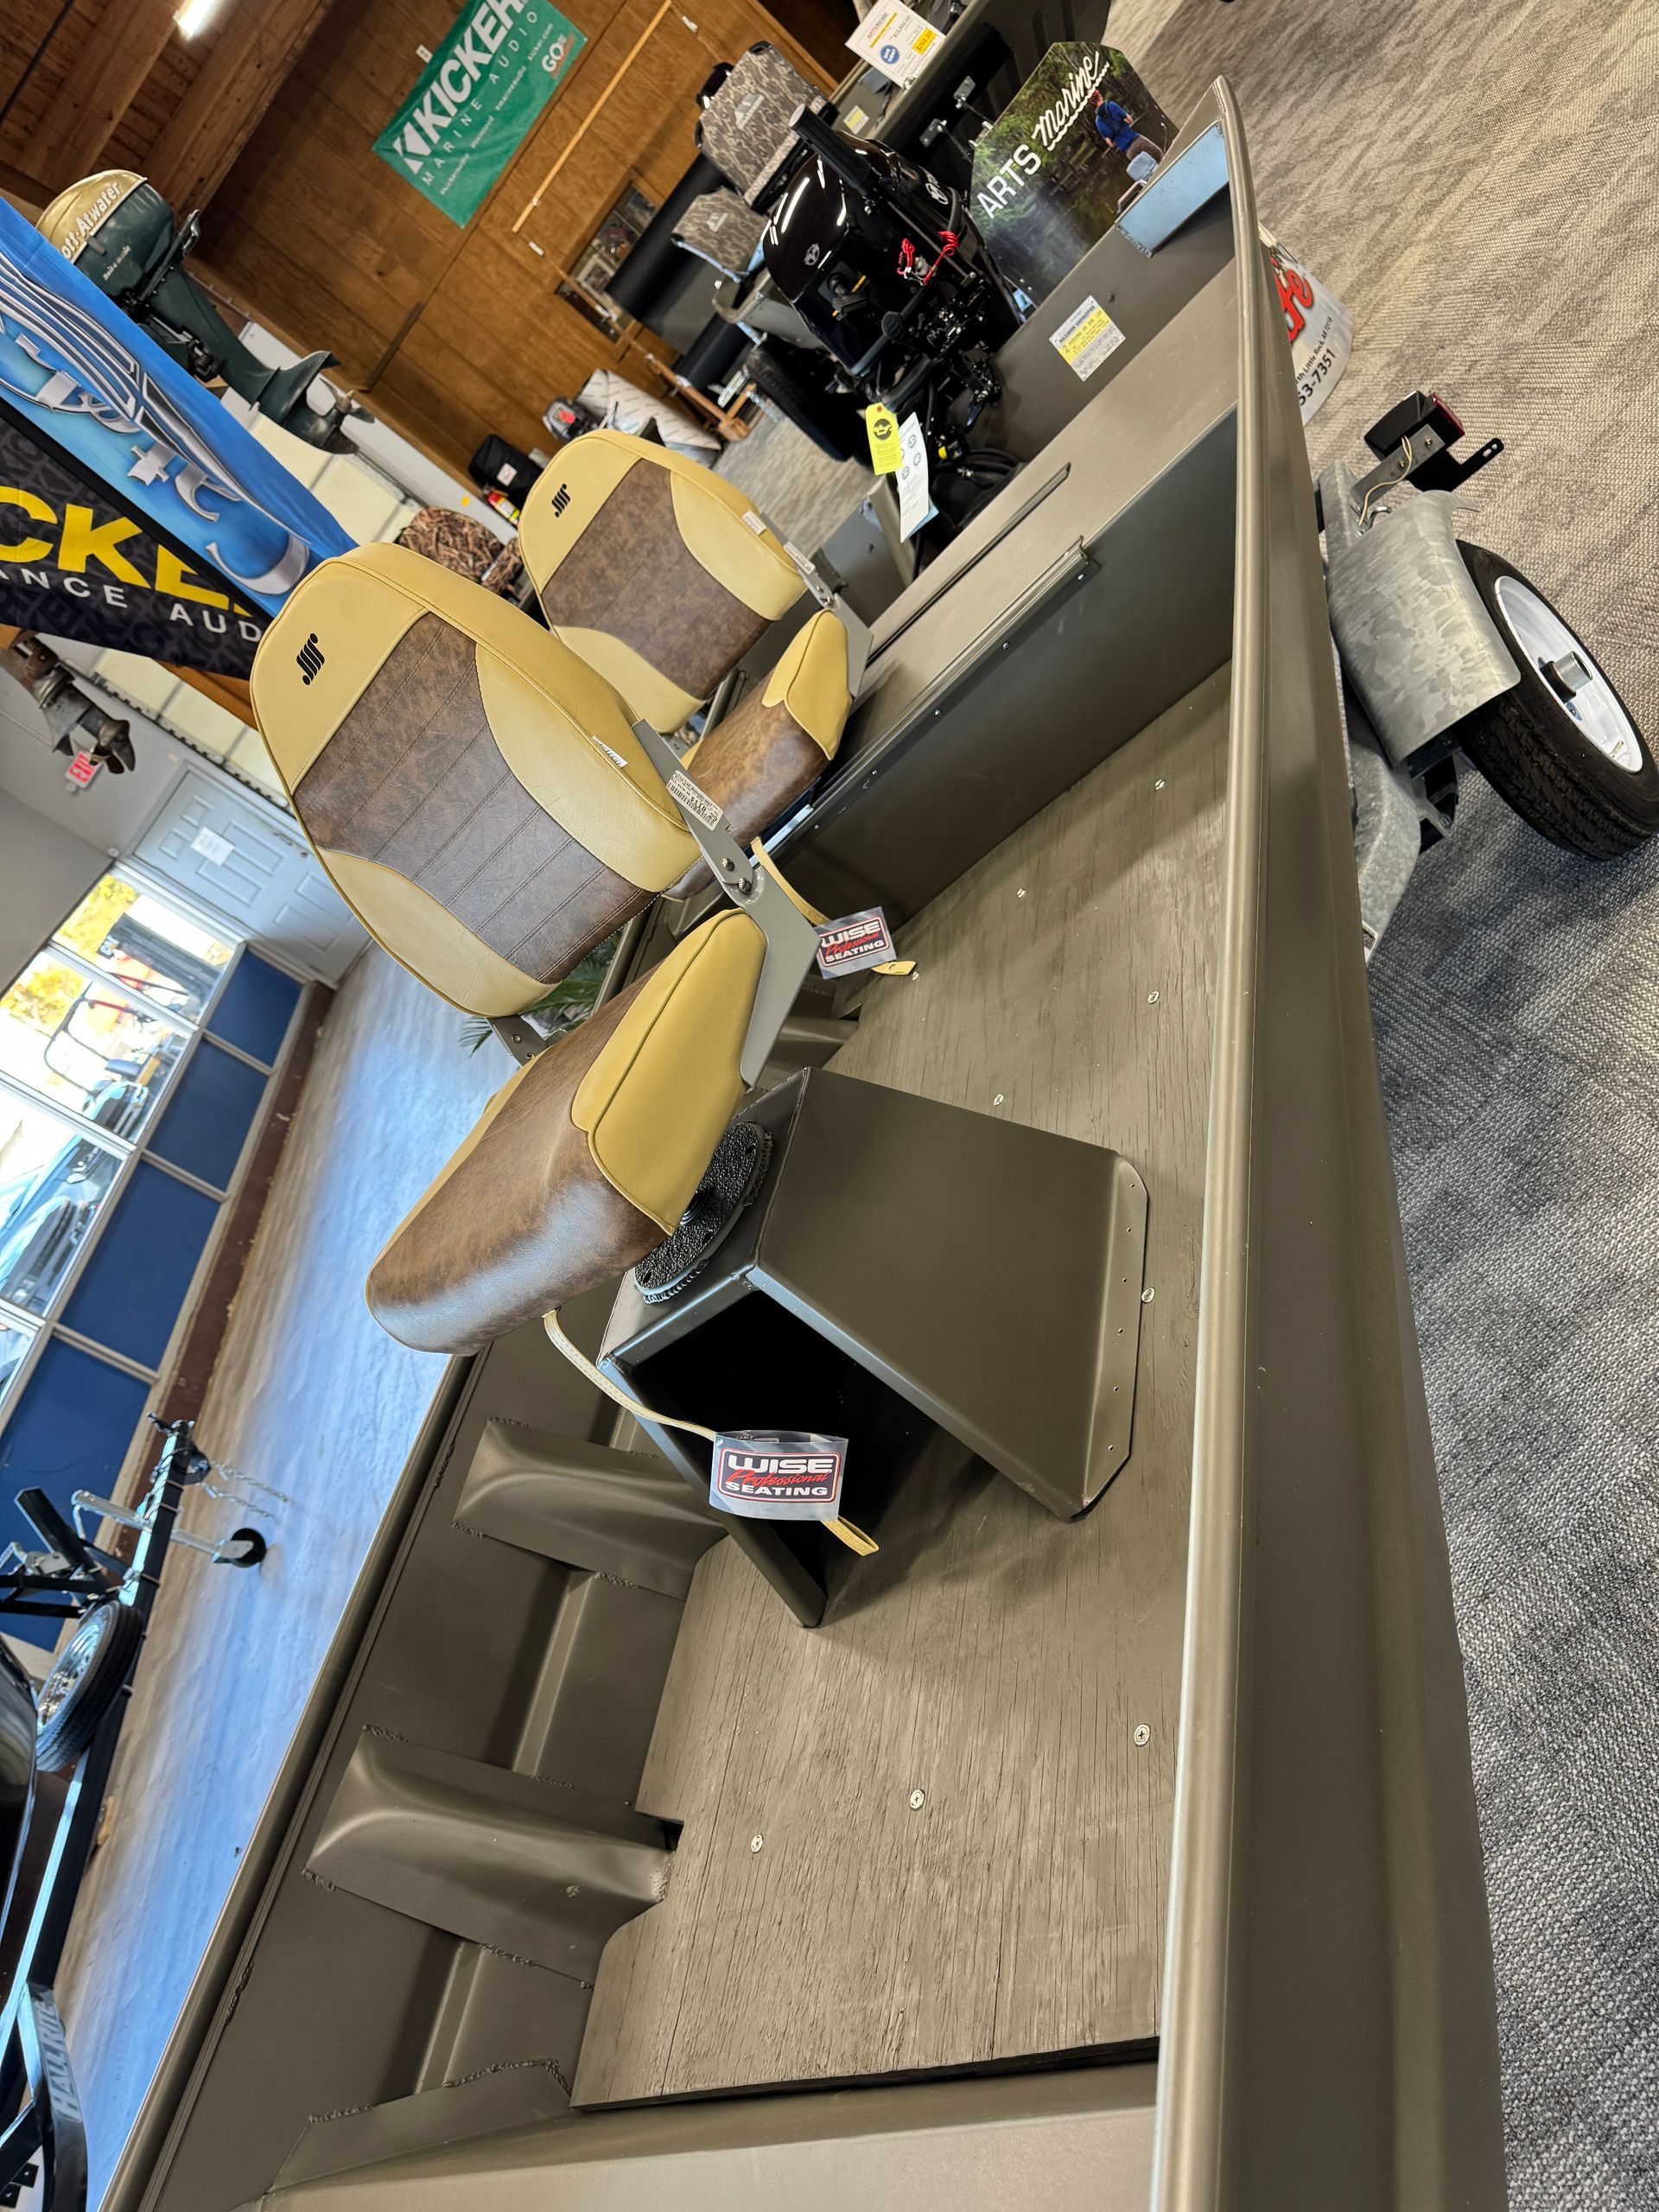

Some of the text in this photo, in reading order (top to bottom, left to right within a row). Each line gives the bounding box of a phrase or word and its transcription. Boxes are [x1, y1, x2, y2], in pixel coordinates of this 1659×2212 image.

[422, 10, 538, 186] MARINE AUDIO
[976, 143, 1042, 219] ARTS
[1303, 353, 1318, 372] Little
[0, 485, 253, 618] CKE
[821, 920, 881, 948] WISE
[824, 931, 880, 957] Professional
[825, 939, 885, 963] SEATING
[728, 1454, 835, 1474] WISE
[725, 1469, 832, 1488] Professional
[725, 1481, 829, 1496] SEATING
